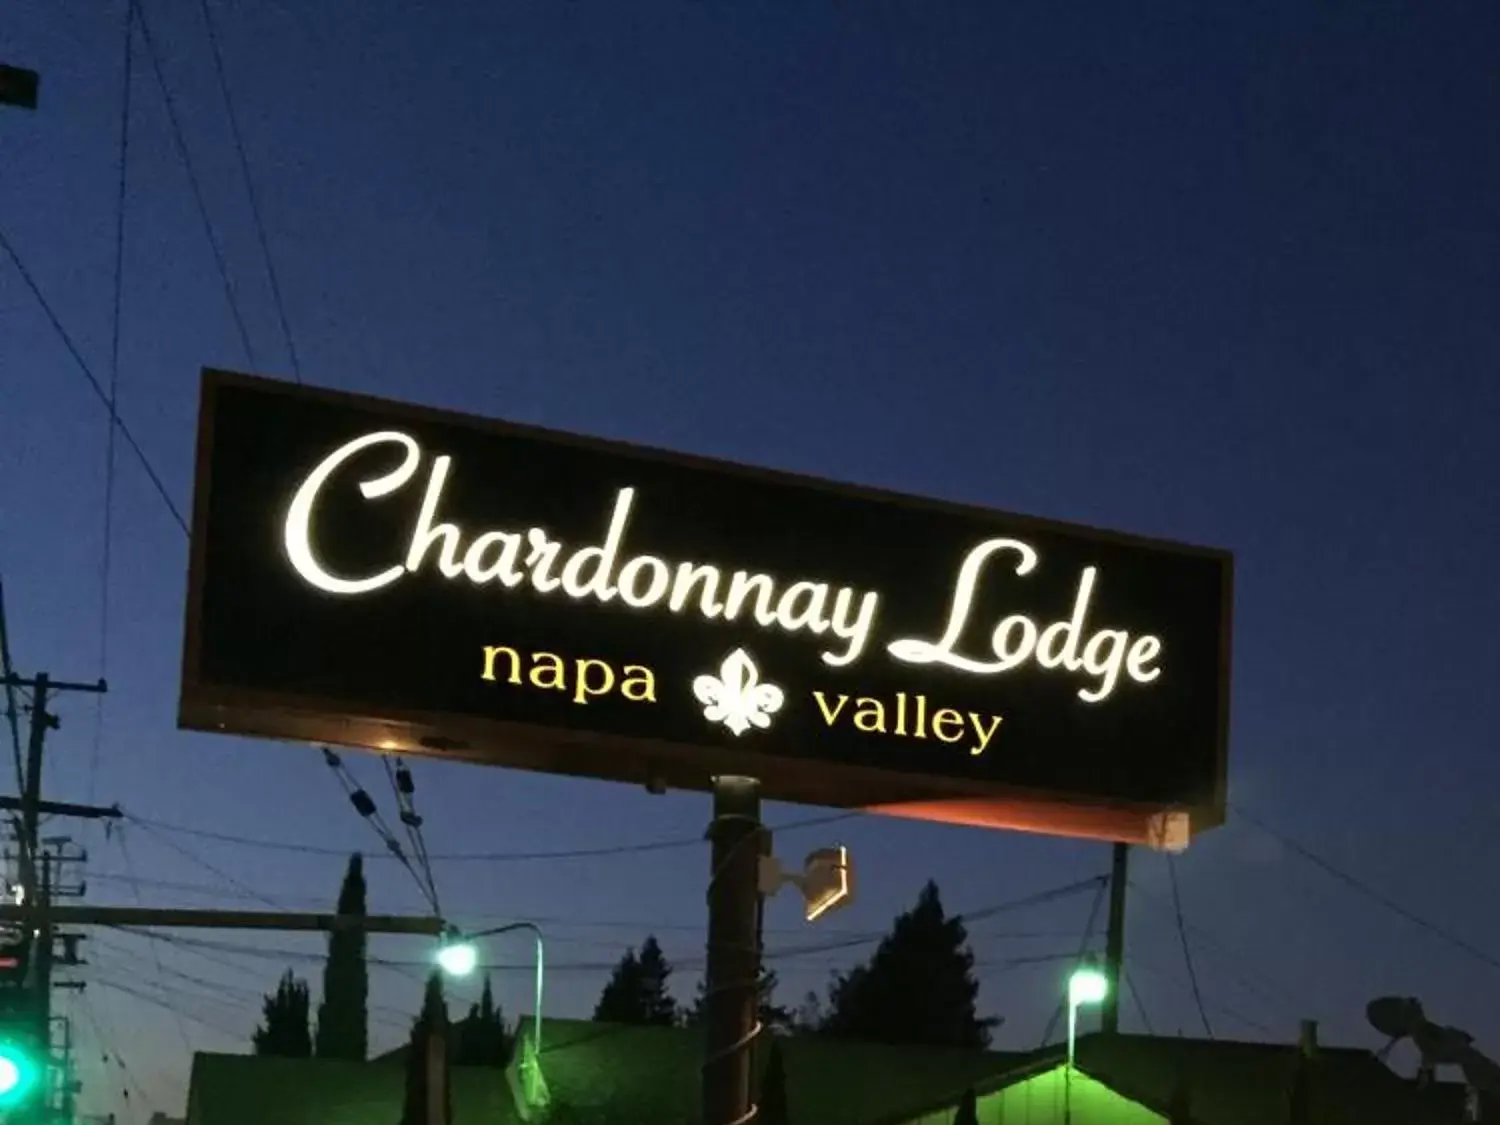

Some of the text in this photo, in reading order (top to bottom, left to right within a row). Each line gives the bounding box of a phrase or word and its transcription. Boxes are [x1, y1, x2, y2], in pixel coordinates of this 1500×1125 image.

[282, 428, 1163, 704] Chardonnay Lodge
[480, 644, 1004, 756] napa valley
